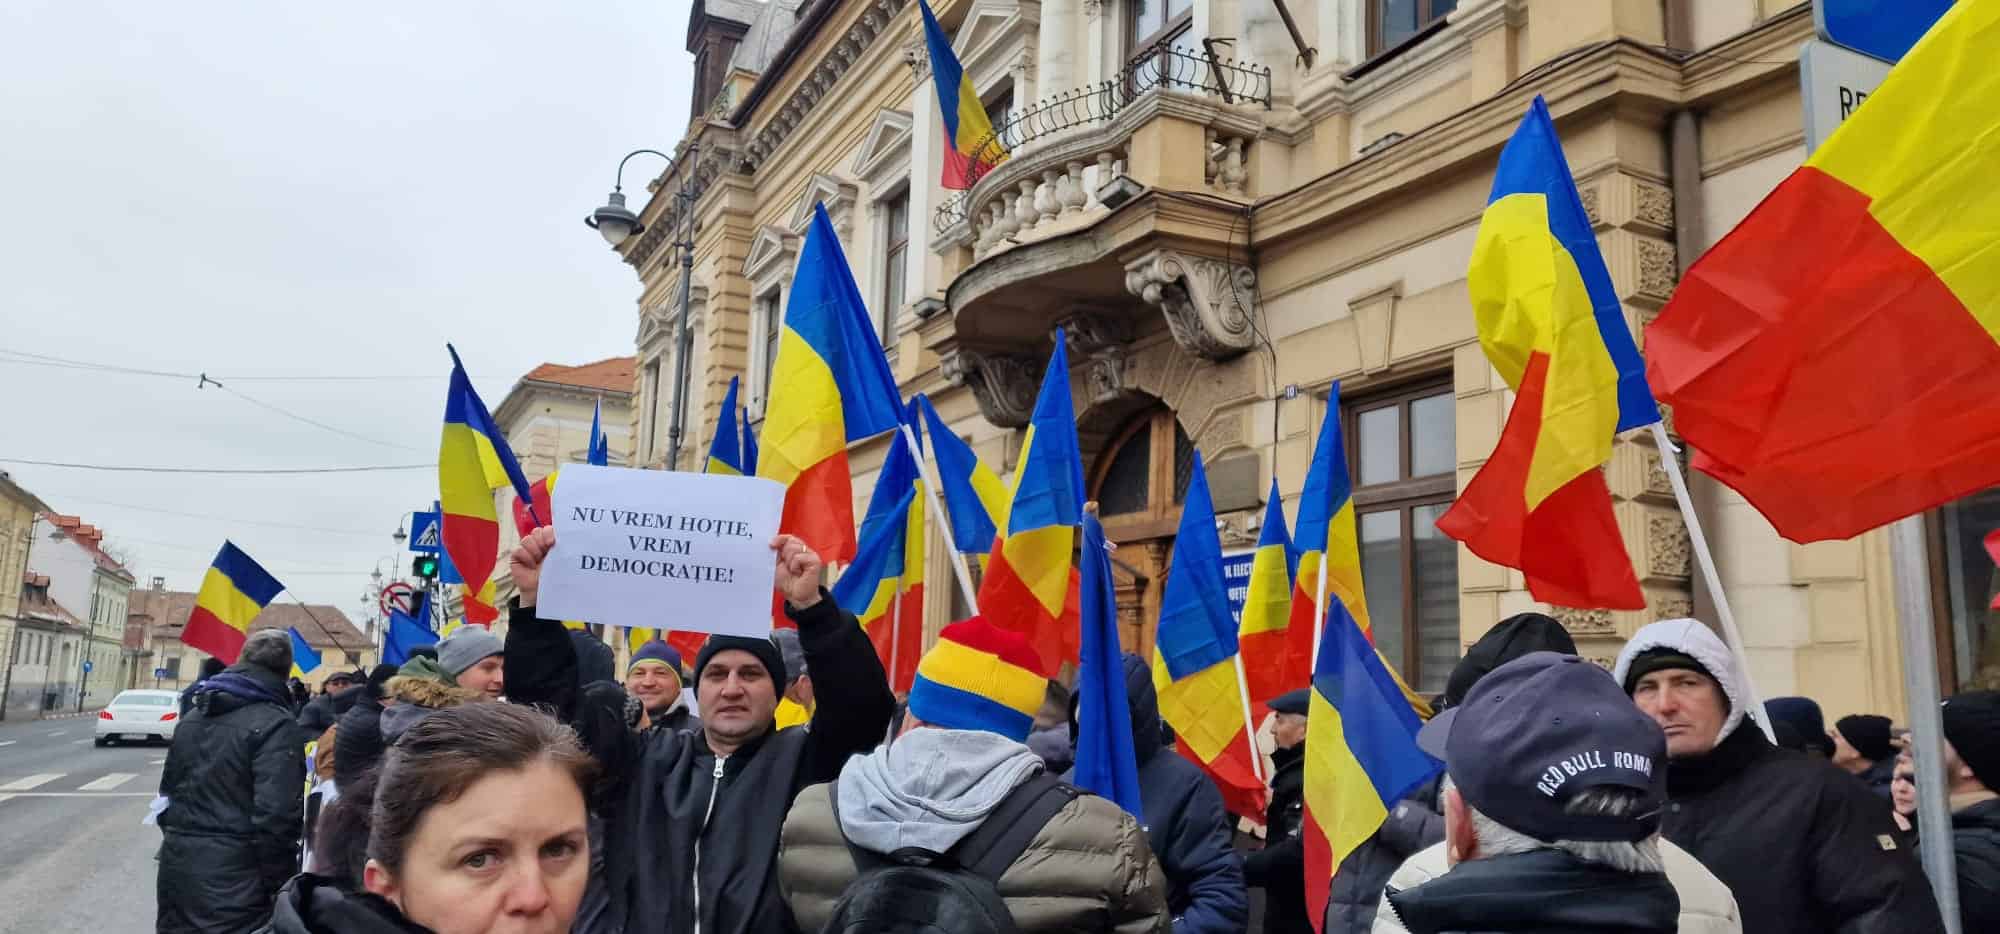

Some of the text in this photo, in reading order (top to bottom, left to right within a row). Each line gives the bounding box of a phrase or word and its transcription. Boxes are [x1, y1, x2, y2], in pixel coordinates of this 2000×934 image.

[573, 506, 753, 539] NU VREM HOȚIE,
[628, 535, 691, 555] VREM
[581, 555, 734, 583] DEMOCRAȚIE!
[1537, 765, 1566, 797] RED
[1561, 751, 1607, 776] BULL
